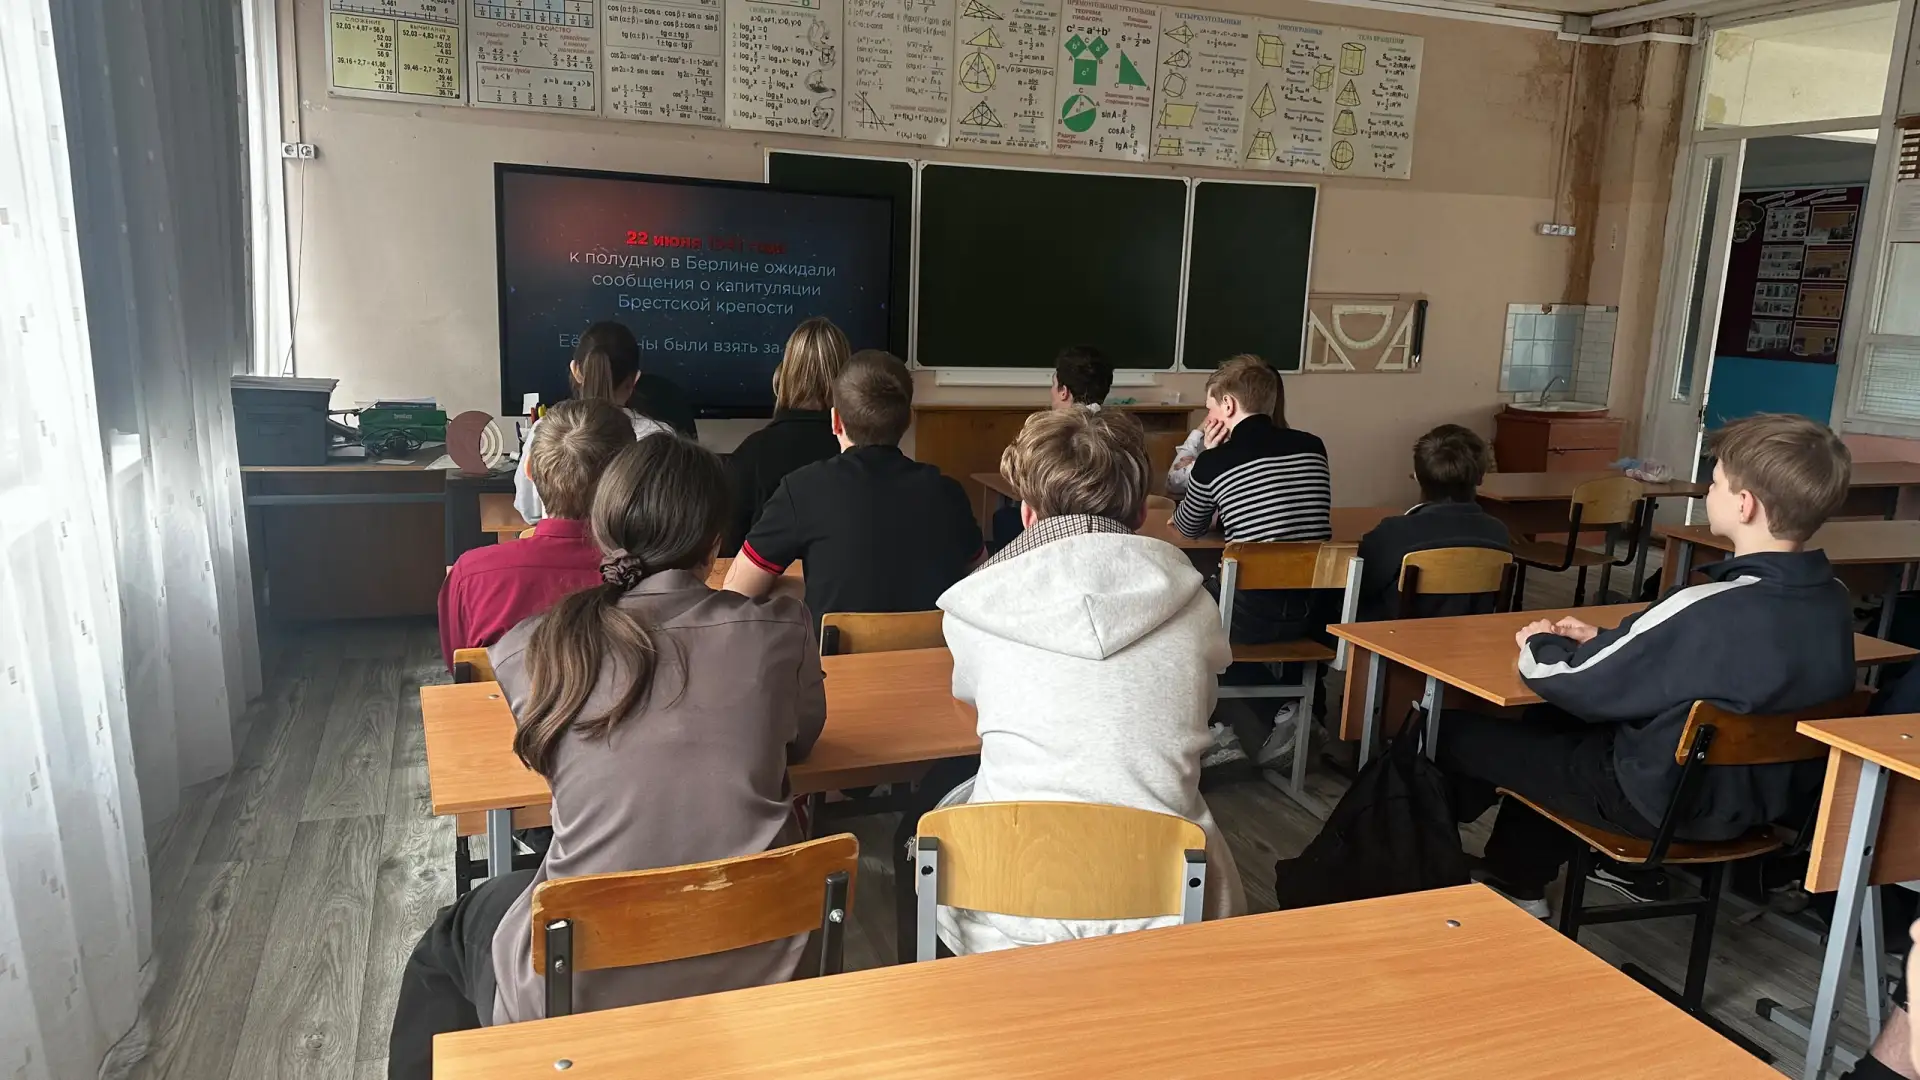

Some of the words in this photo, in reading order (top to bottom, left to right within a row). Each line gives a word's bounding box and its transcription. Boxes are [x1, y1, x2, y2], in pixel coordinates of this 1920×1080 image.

[336, 22, 351, 30] 52,03
[345, 17, 380, 25] СЛОЖЕНИЕ
[625, 229, 648, 246] 22
[654, 235, 702, 250] июня
[570, 252, 579, 263] к
[585, 253, 665, 268] полудню
[671, 258, 680, 269] в
[686, 256, 759, 273] Берлине
[764, 264, 836, 277] ожидали
[592, 274, 694, 290] сообщения
[700, 280, 710, 291] о
[716, 282, 821, 296] капитуляции
[618, 294, 711, 312] Брестской
[716, 301, 794, 316] крепости
[664, 339, 708, 352] были
[714, 341, 758, 353] взять
